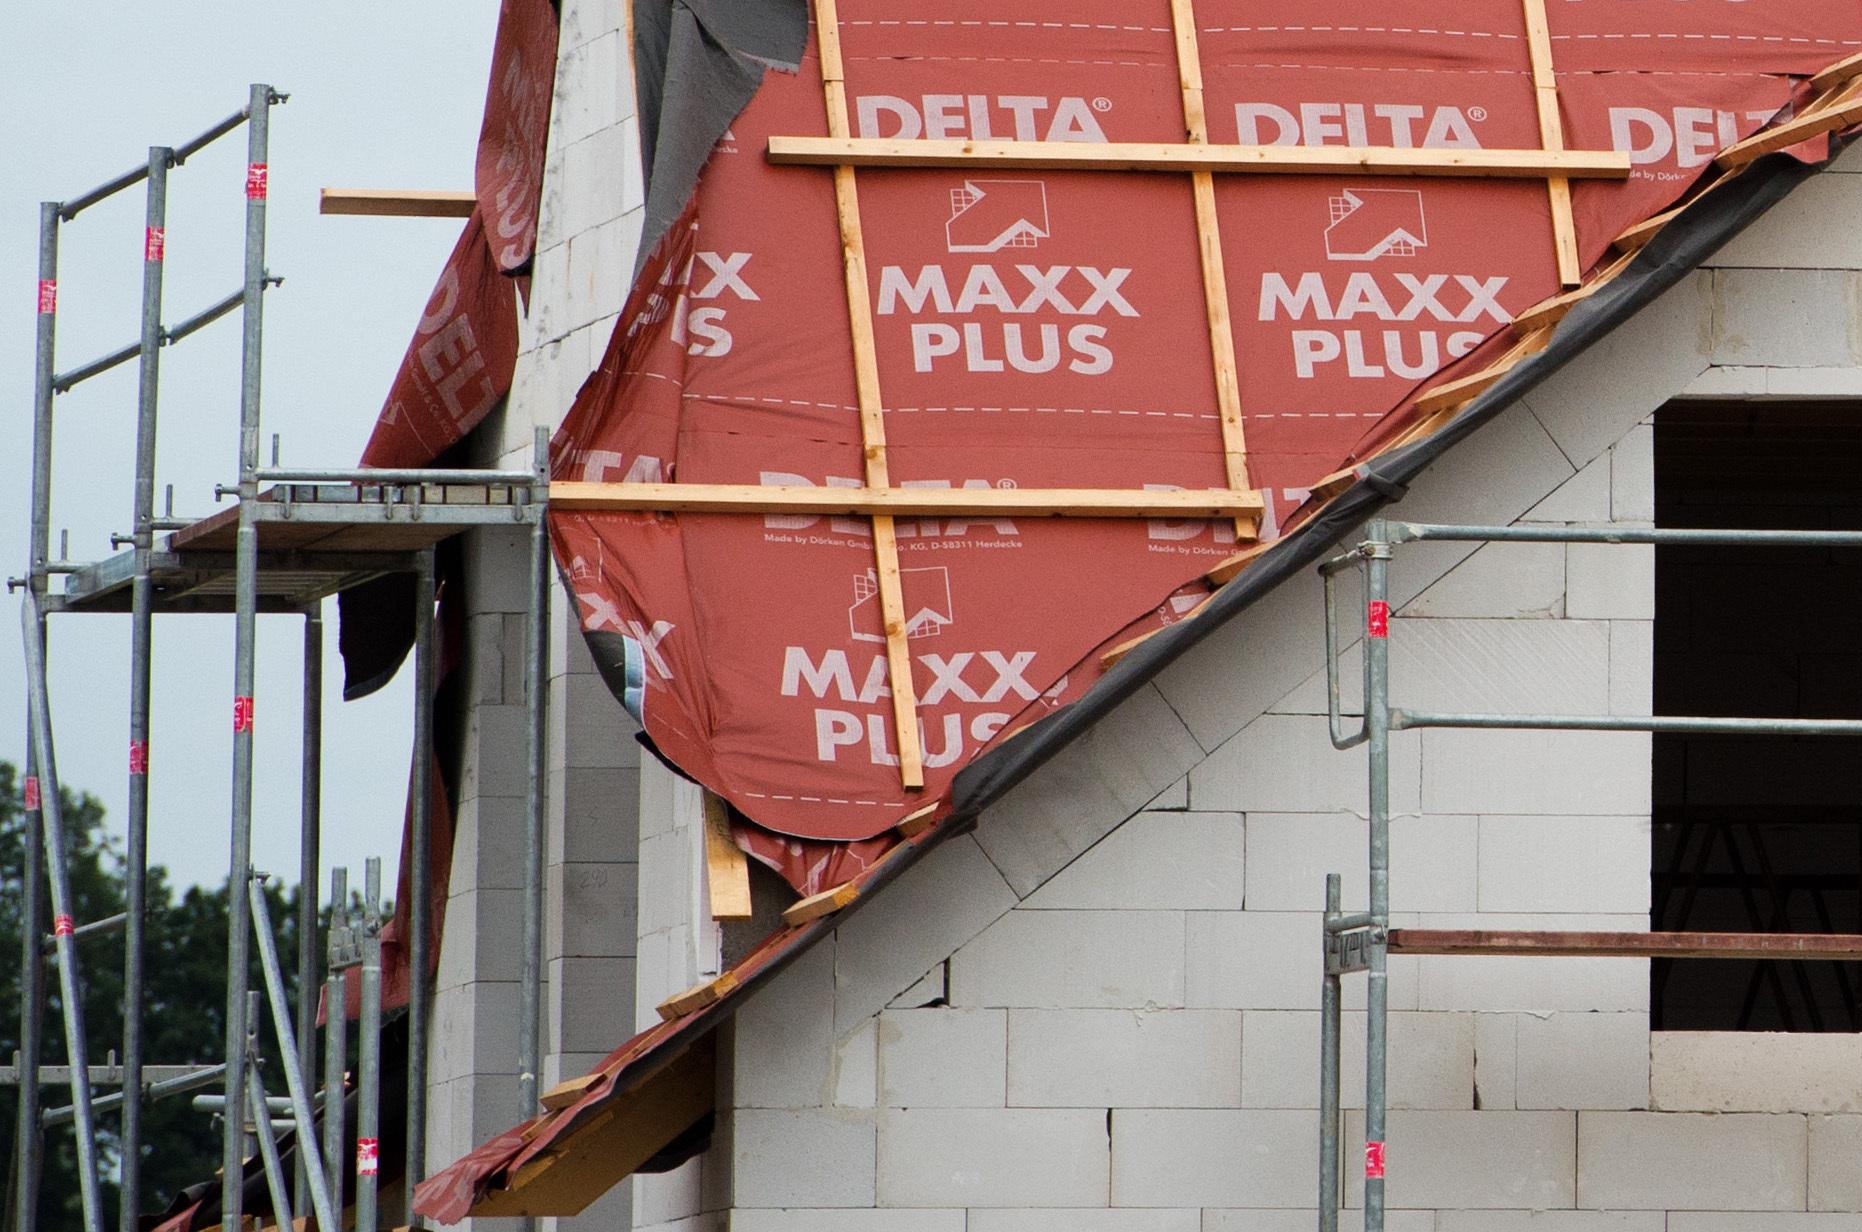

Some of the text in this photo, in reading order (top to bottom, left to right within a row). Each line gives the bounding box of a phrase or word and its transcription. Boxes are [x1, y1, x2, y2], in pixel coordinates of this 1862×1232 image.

[877, 264, 1140, 317] MAXX
[1258, 272, 1513, 323] MAXX
[911, 323, 1113, 375] PLUS
[848, 540, 872, 550] Gmb
